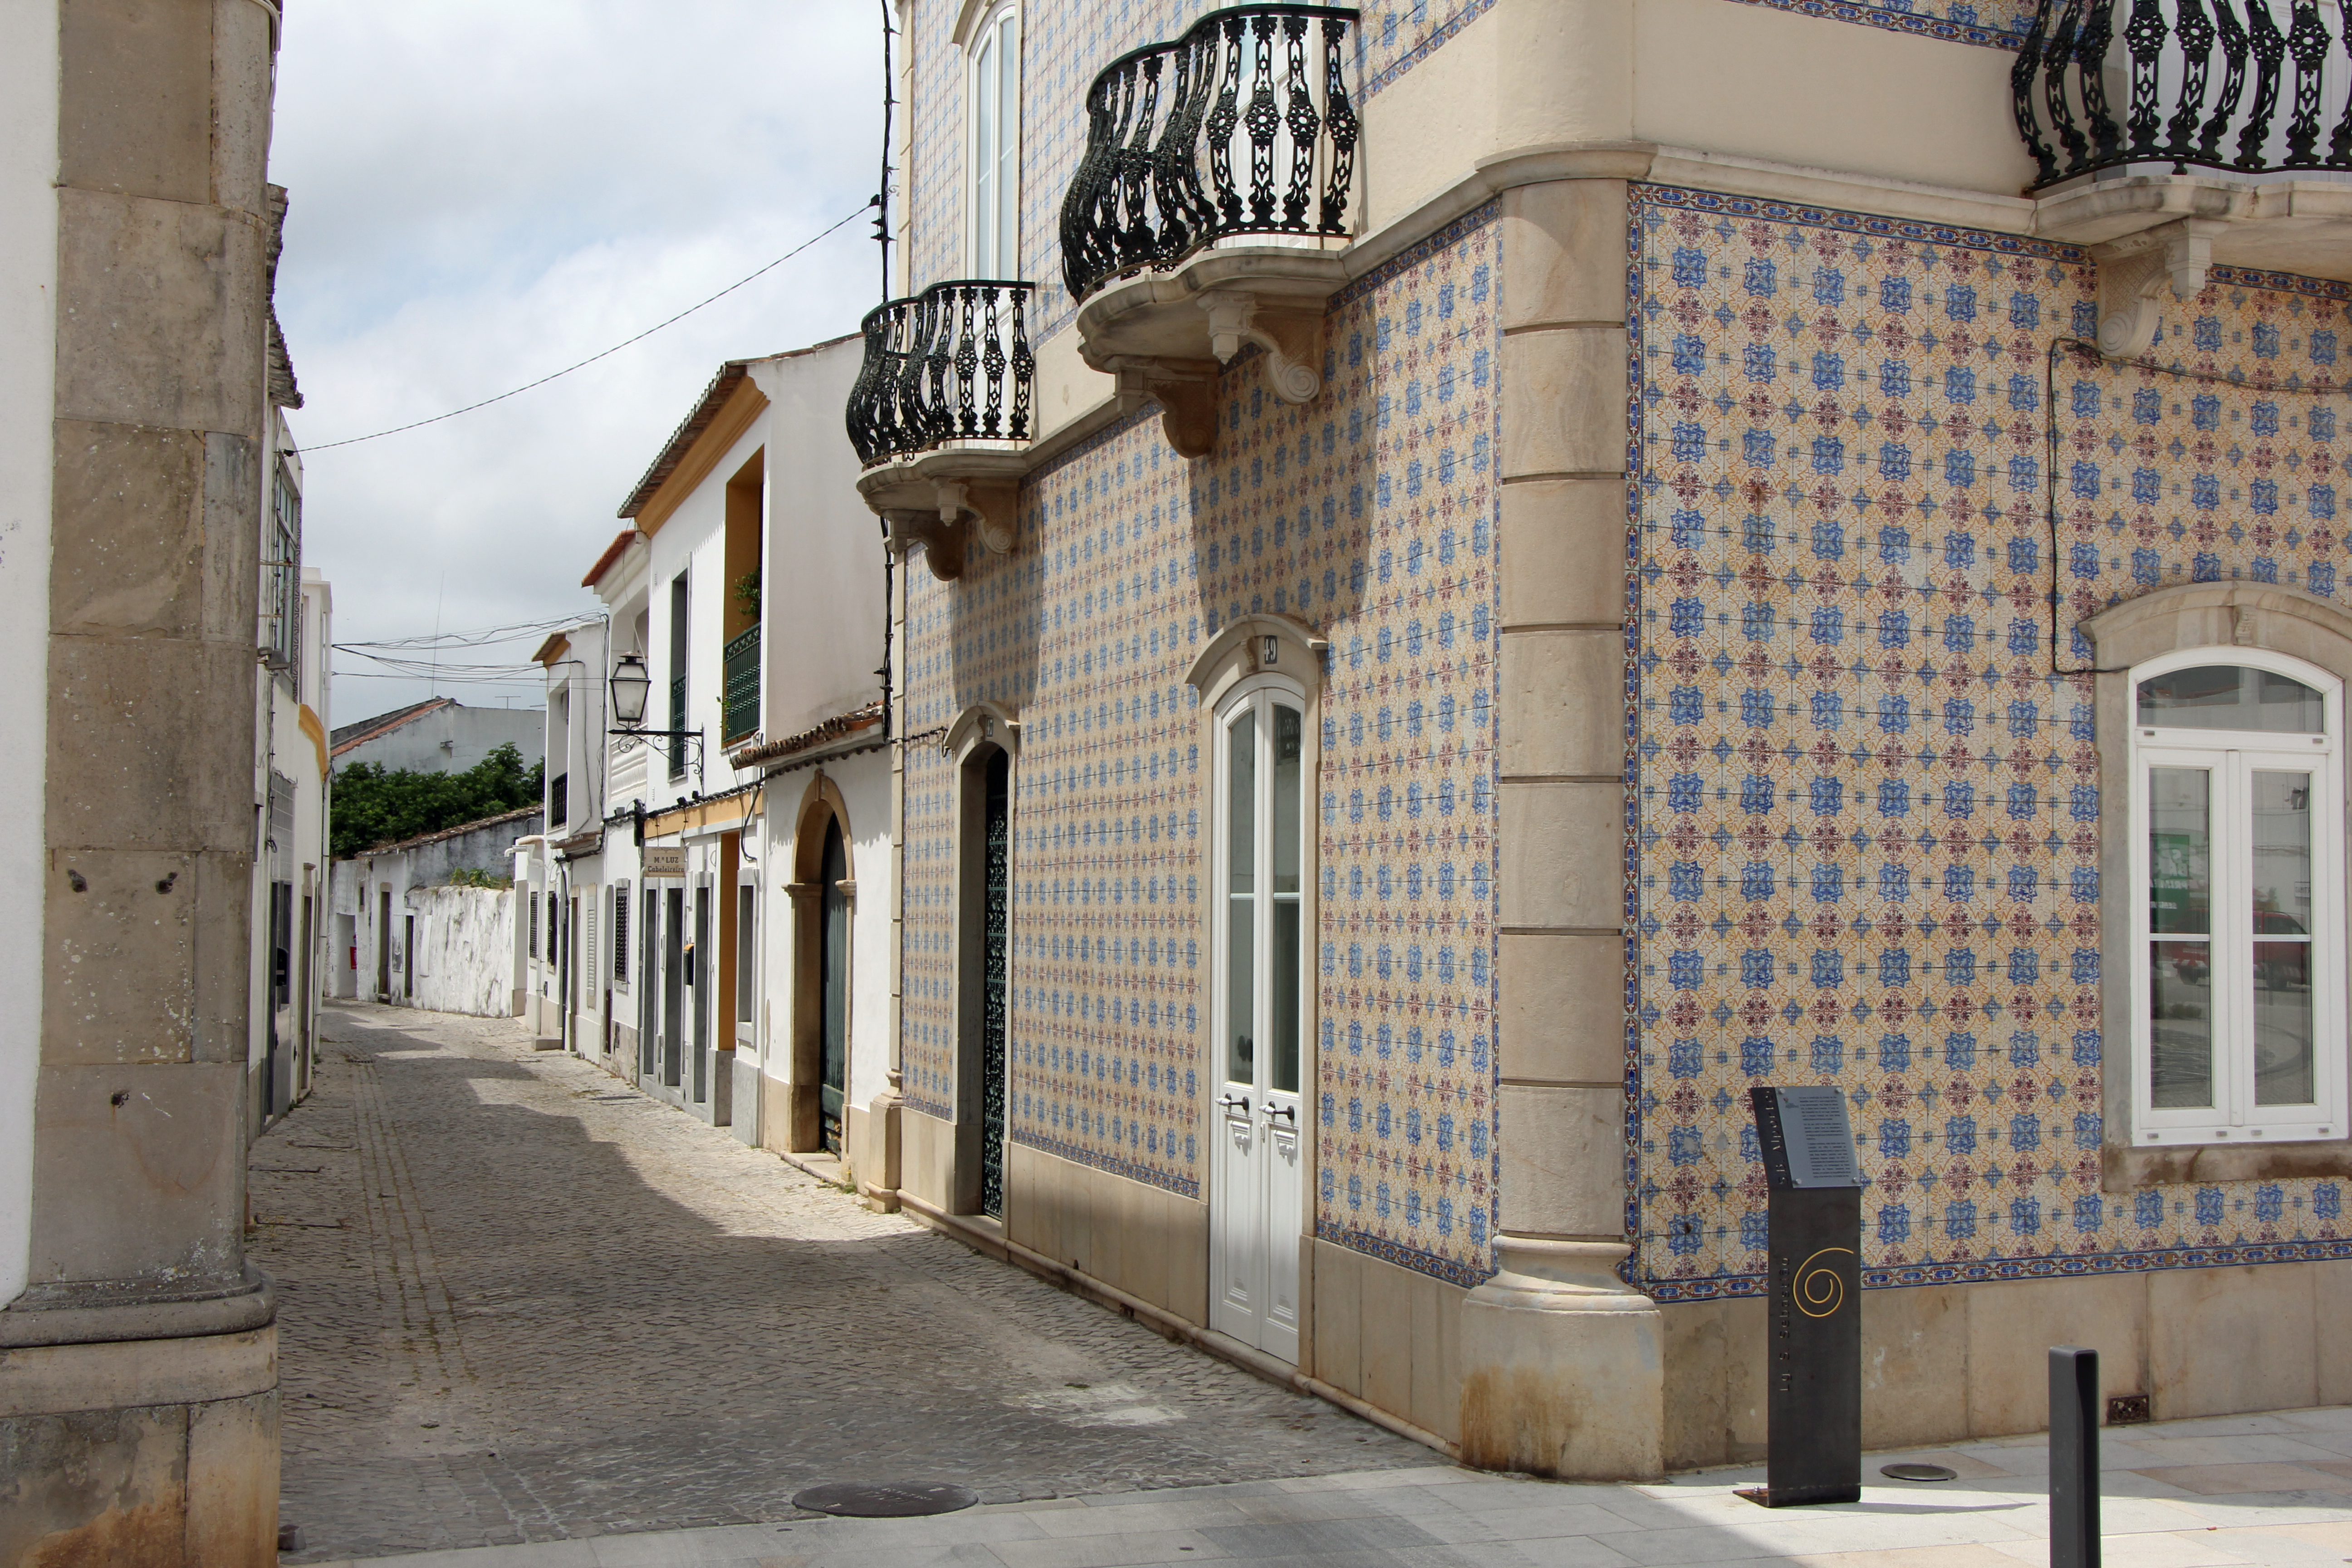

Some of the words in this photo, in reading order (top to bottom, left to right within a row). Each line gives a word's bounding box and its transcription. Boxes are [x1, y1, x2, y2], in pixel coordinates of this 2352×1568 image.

[1264, 638, 1276, 661] 49
[1765, 1091, 1783, 1153] Alportel
[1779, 1258, 1790, 1338] Sebastião
